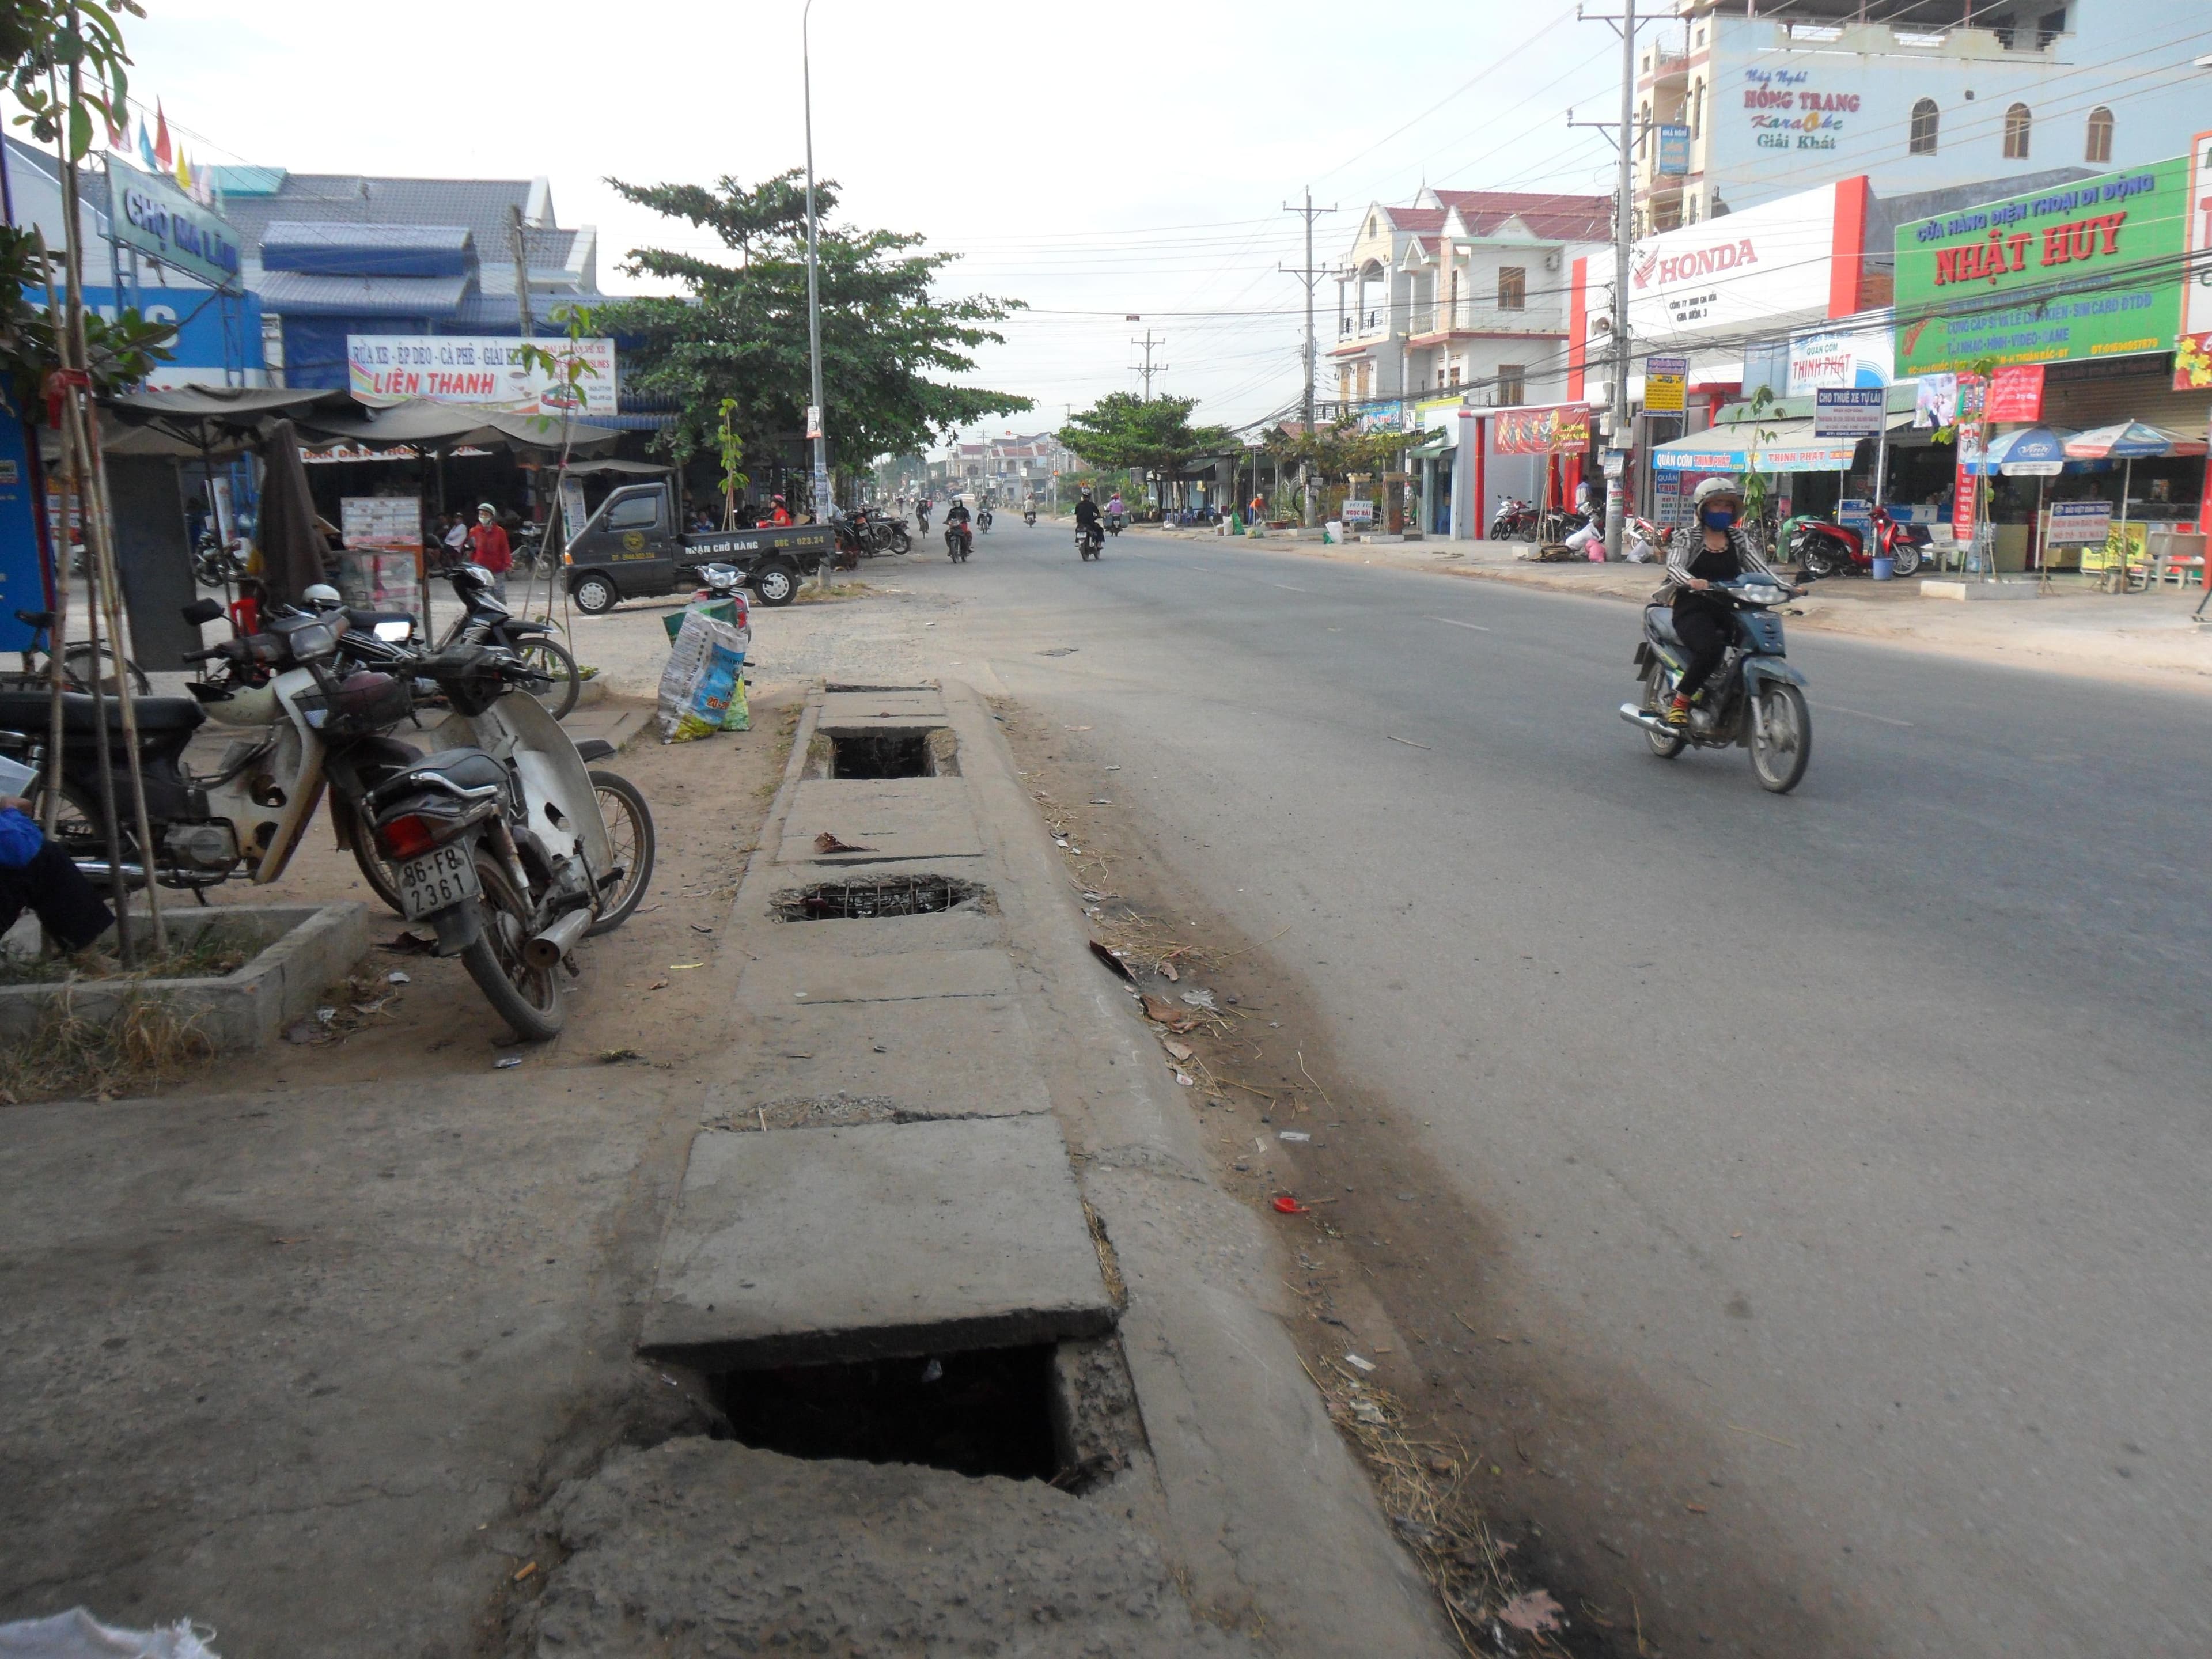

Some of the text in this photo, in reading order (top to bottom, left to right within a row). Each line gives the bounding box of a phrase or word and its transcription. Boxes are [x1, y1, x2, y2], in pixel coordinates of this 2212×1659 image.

[1798, 92, 1860, 112] TRANG
[1758, 133, 1836, 149] Giải Khát
[1916, 173, 2154, 242] CỬA HÀNG ĐIỆN THOẠI DI ĐỘNG
[1934, 211, 2127, 285] NHẬT HUY
[1659, 238, 1758, 285] HONDA
[1677, 312, 1687, 322] GIA
[1703, 308, 1707, 317] 3
[2074, 302, 2091, 317] SIM
[2092, 297, 2118, 315] CARD
[2012, 331, 2037, 347] VIDEO
[376, 346, 388, 365] XE
[441, 342, 454, 365] CÀ
[1793, 357, 1821, 382] THỊNH
[373, 367, 494, 395] LIÊN THANH
[1819, 392, 1832, 403] CHO
[1834, 391, 1850, 403] THUÊ
[1851, 392, 1859, 403] XE
[1861, 391, 1870, 406] TỰ
[1657, 452, 1676, 467] QUÁN
[1677, 454, 1692, 467] CƠM
[1768, 452, 1796, 465] THỊNH
[1800, 450, 1825, 461] PHÁT
[1657, 472, 1677, 482] QUÁN
[1658, 484, 1677, 493] THỊN
[734, 540, 759, 551] HÀNG
[404, 849, 458, 887] 86-F8
[411, 873, 464, 912] 2361
